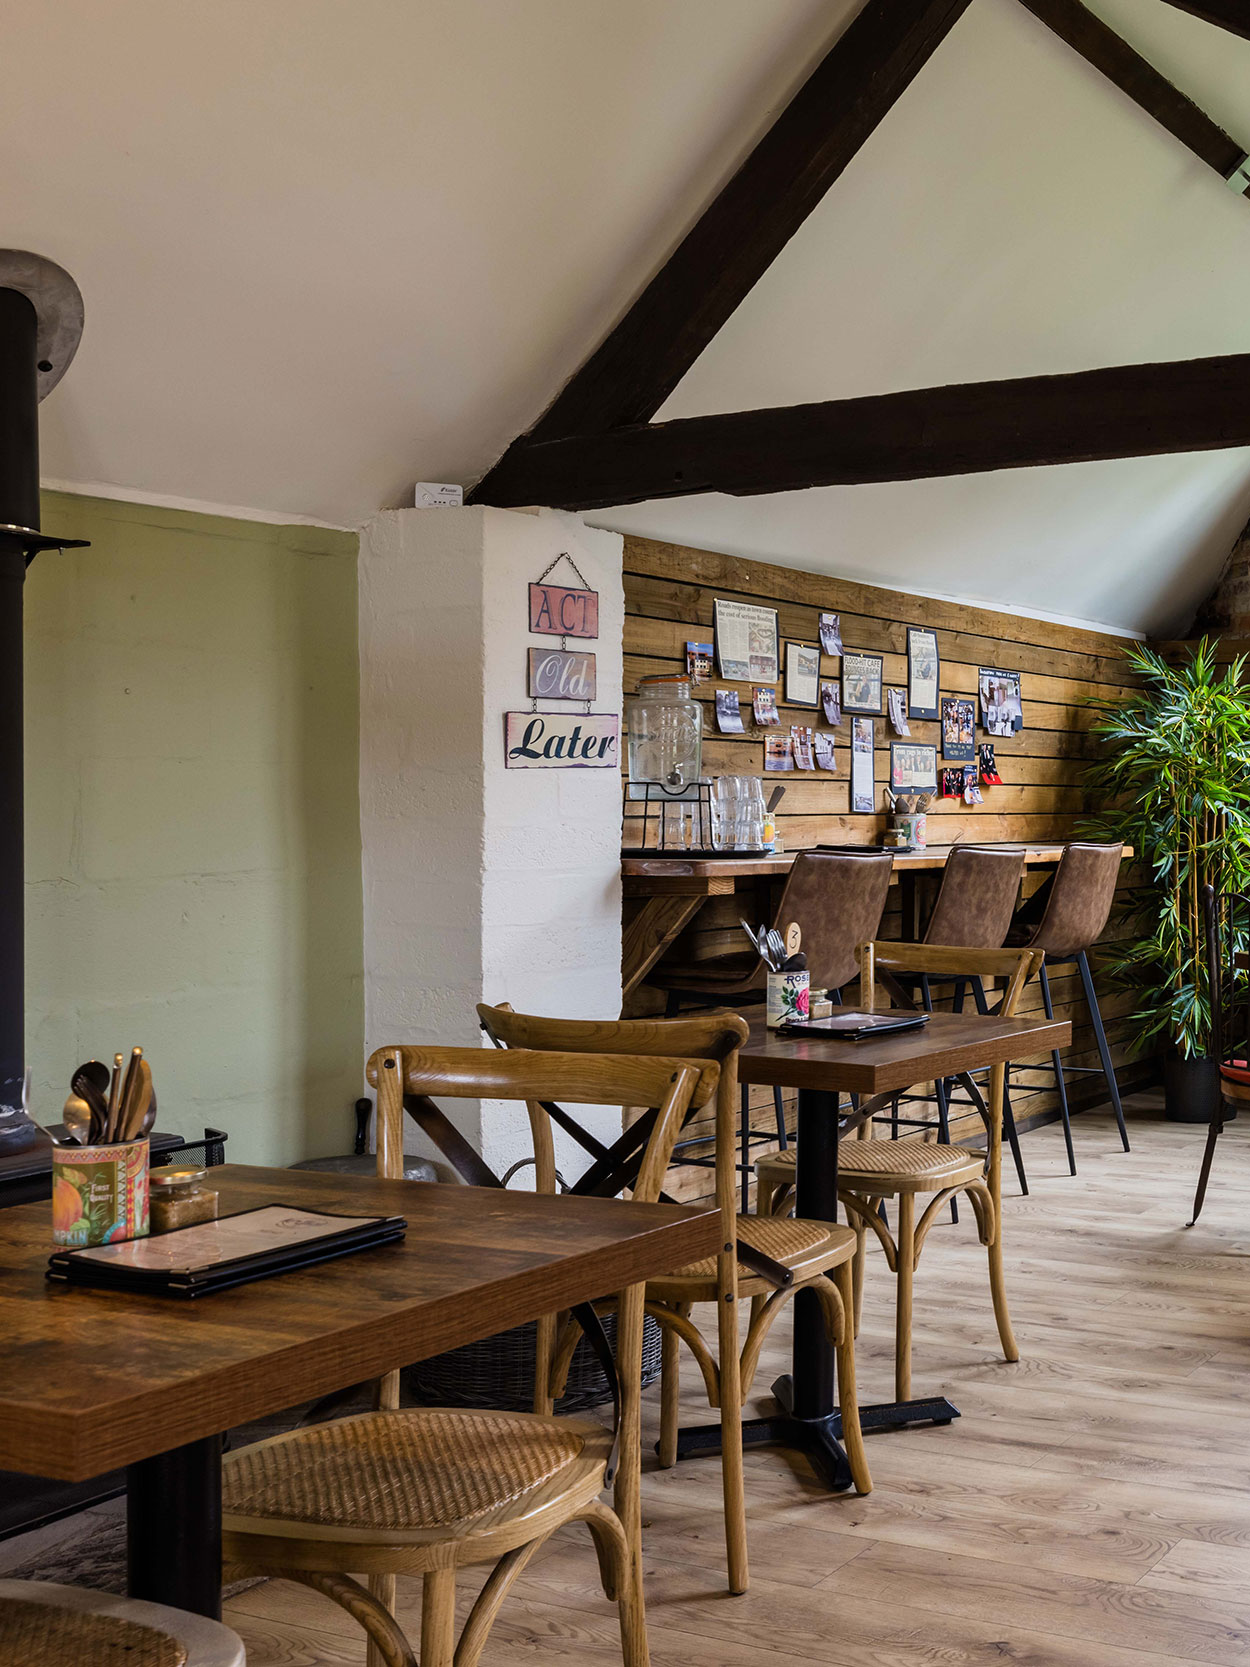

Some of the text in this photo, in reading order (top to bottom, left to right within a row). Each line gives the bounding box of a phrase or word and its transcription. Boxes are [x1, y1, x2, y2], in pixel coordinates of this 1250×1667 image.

[535, 590, 595, 633] ACT
[536, 654, 590, 696] Old
[509, 718, 616, 760] Later
[790, 930, 798, 948] 3
